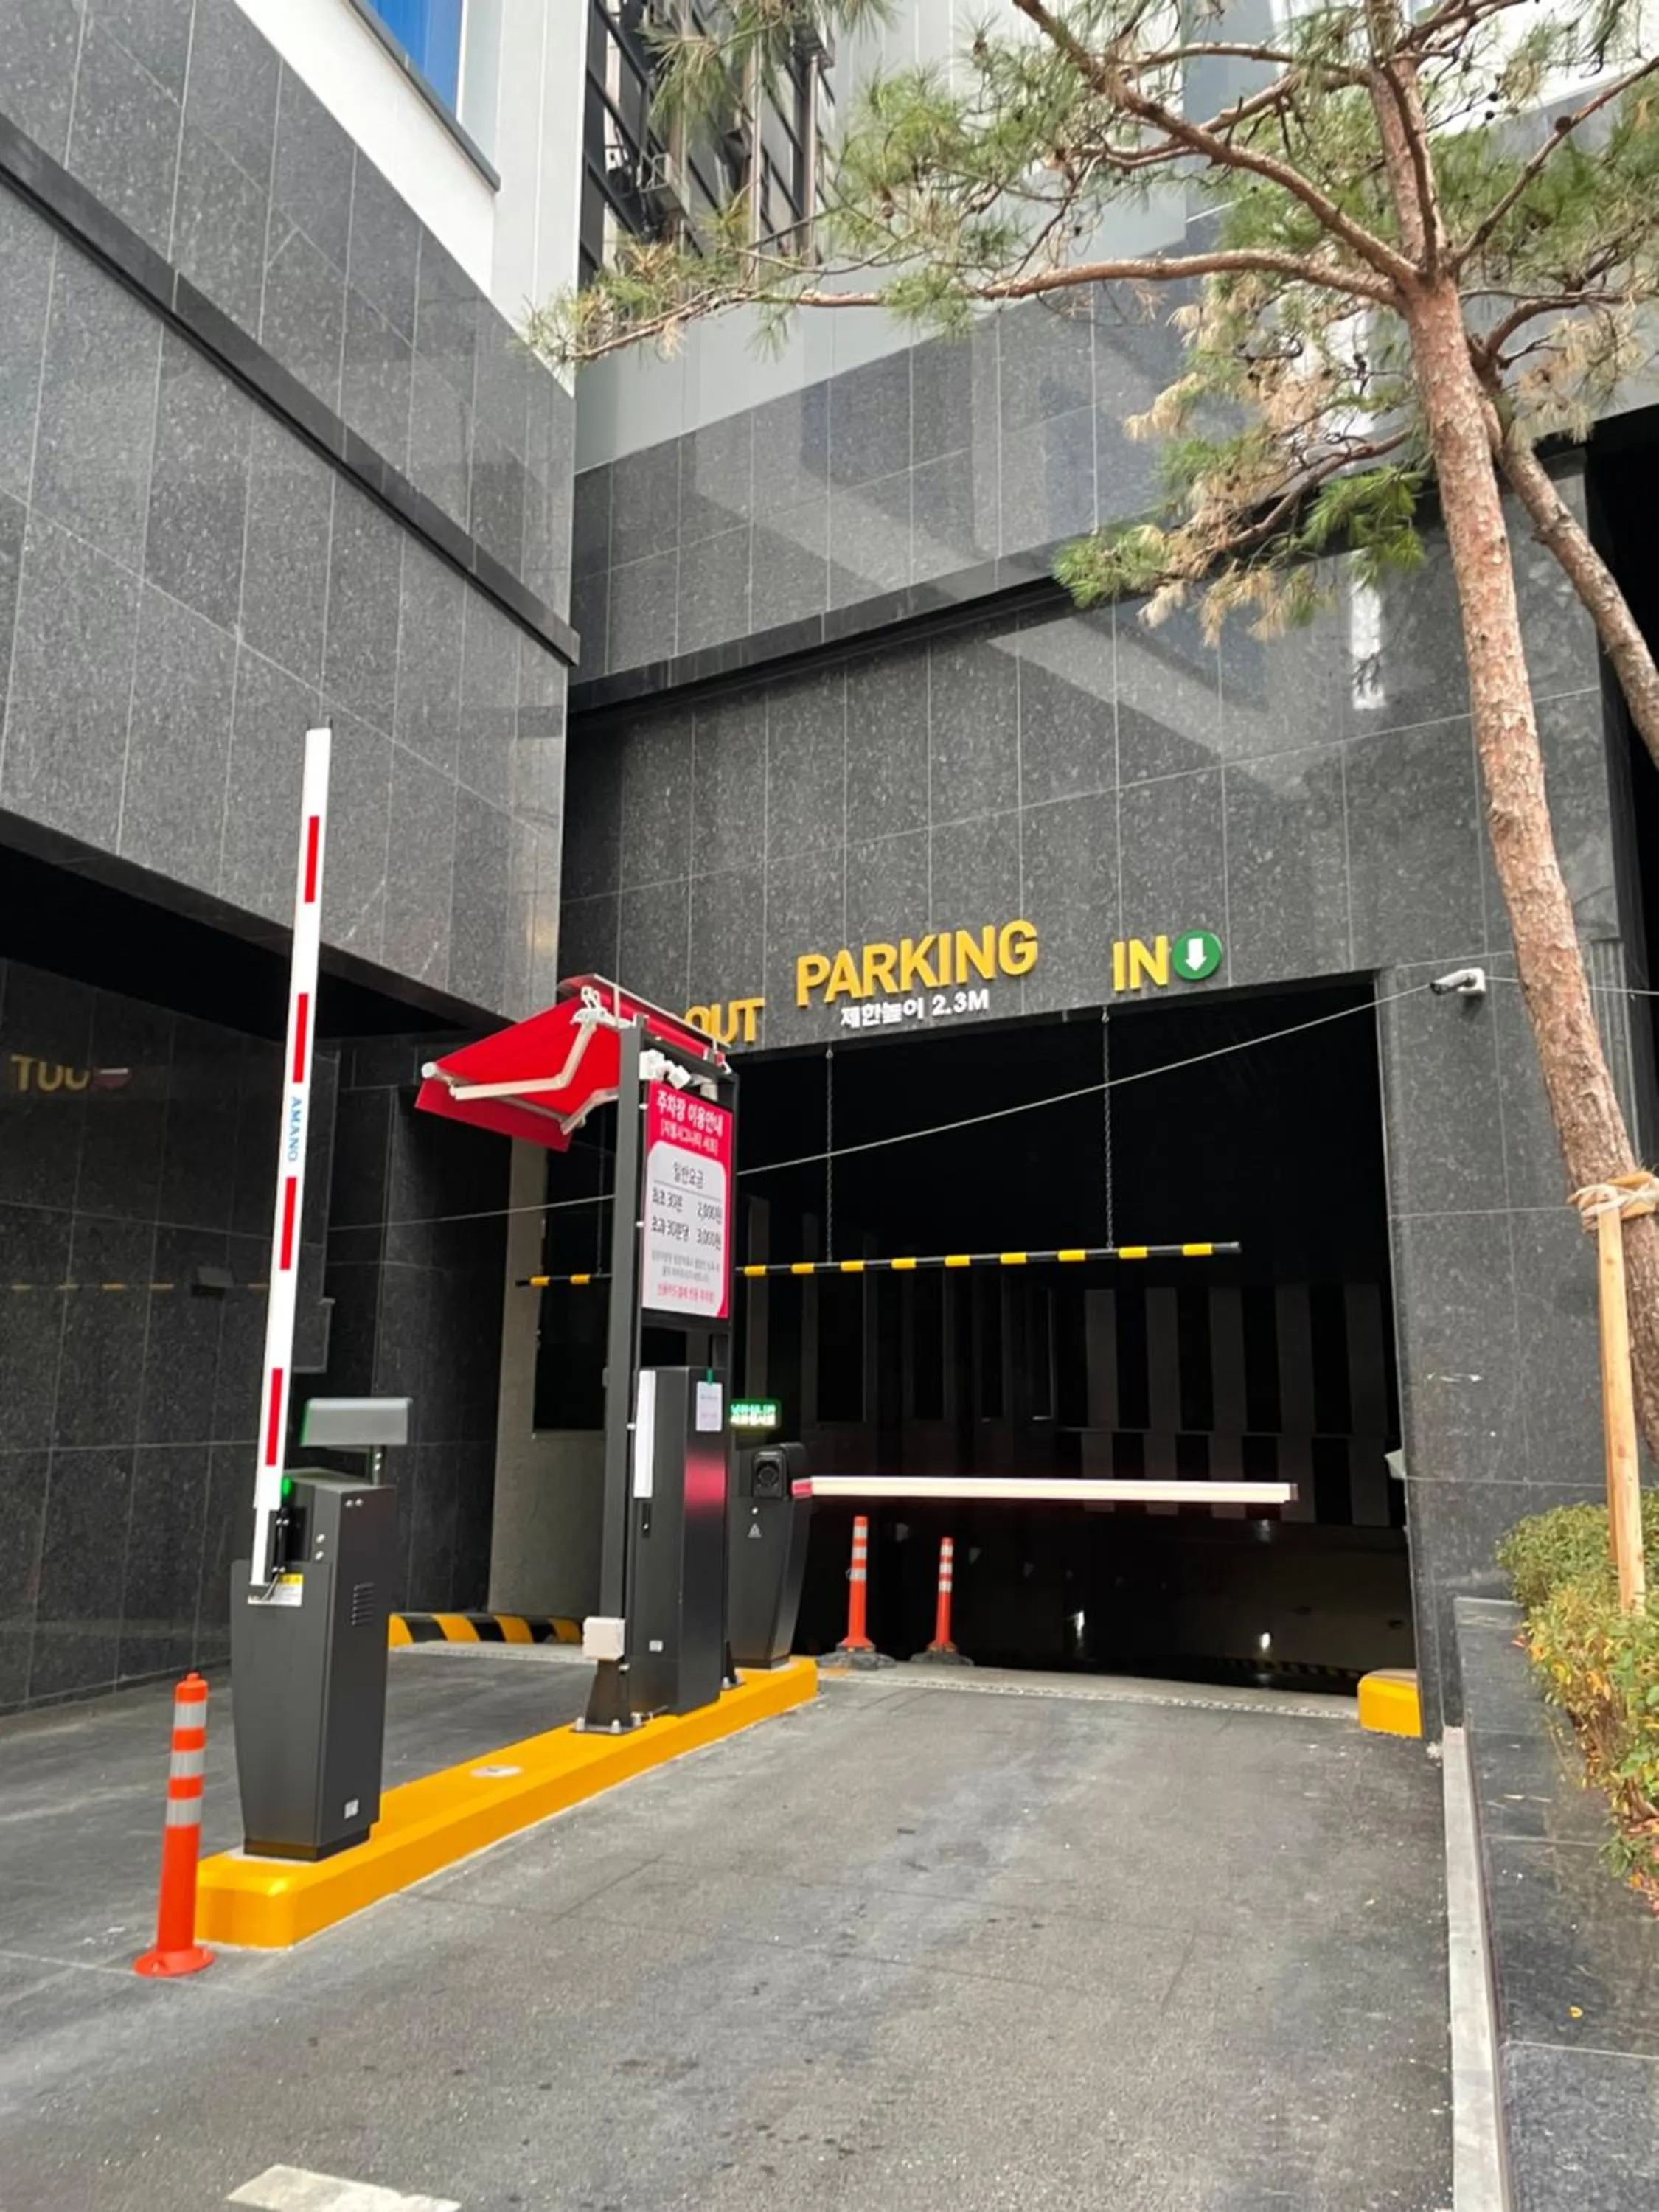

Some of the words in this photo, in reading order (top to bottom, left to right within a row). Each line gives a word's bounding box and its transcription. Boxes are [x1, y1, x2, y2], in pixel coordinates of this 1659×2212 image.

[796, 919, 1040, 1008] PARKING
[1113, 934, 1169, 992] IN
[840, 998, 925, 1029] 제한높이
[932, 988, 990, 1015] 2.3M
[288, 1096, 303, 1162] AMANO
